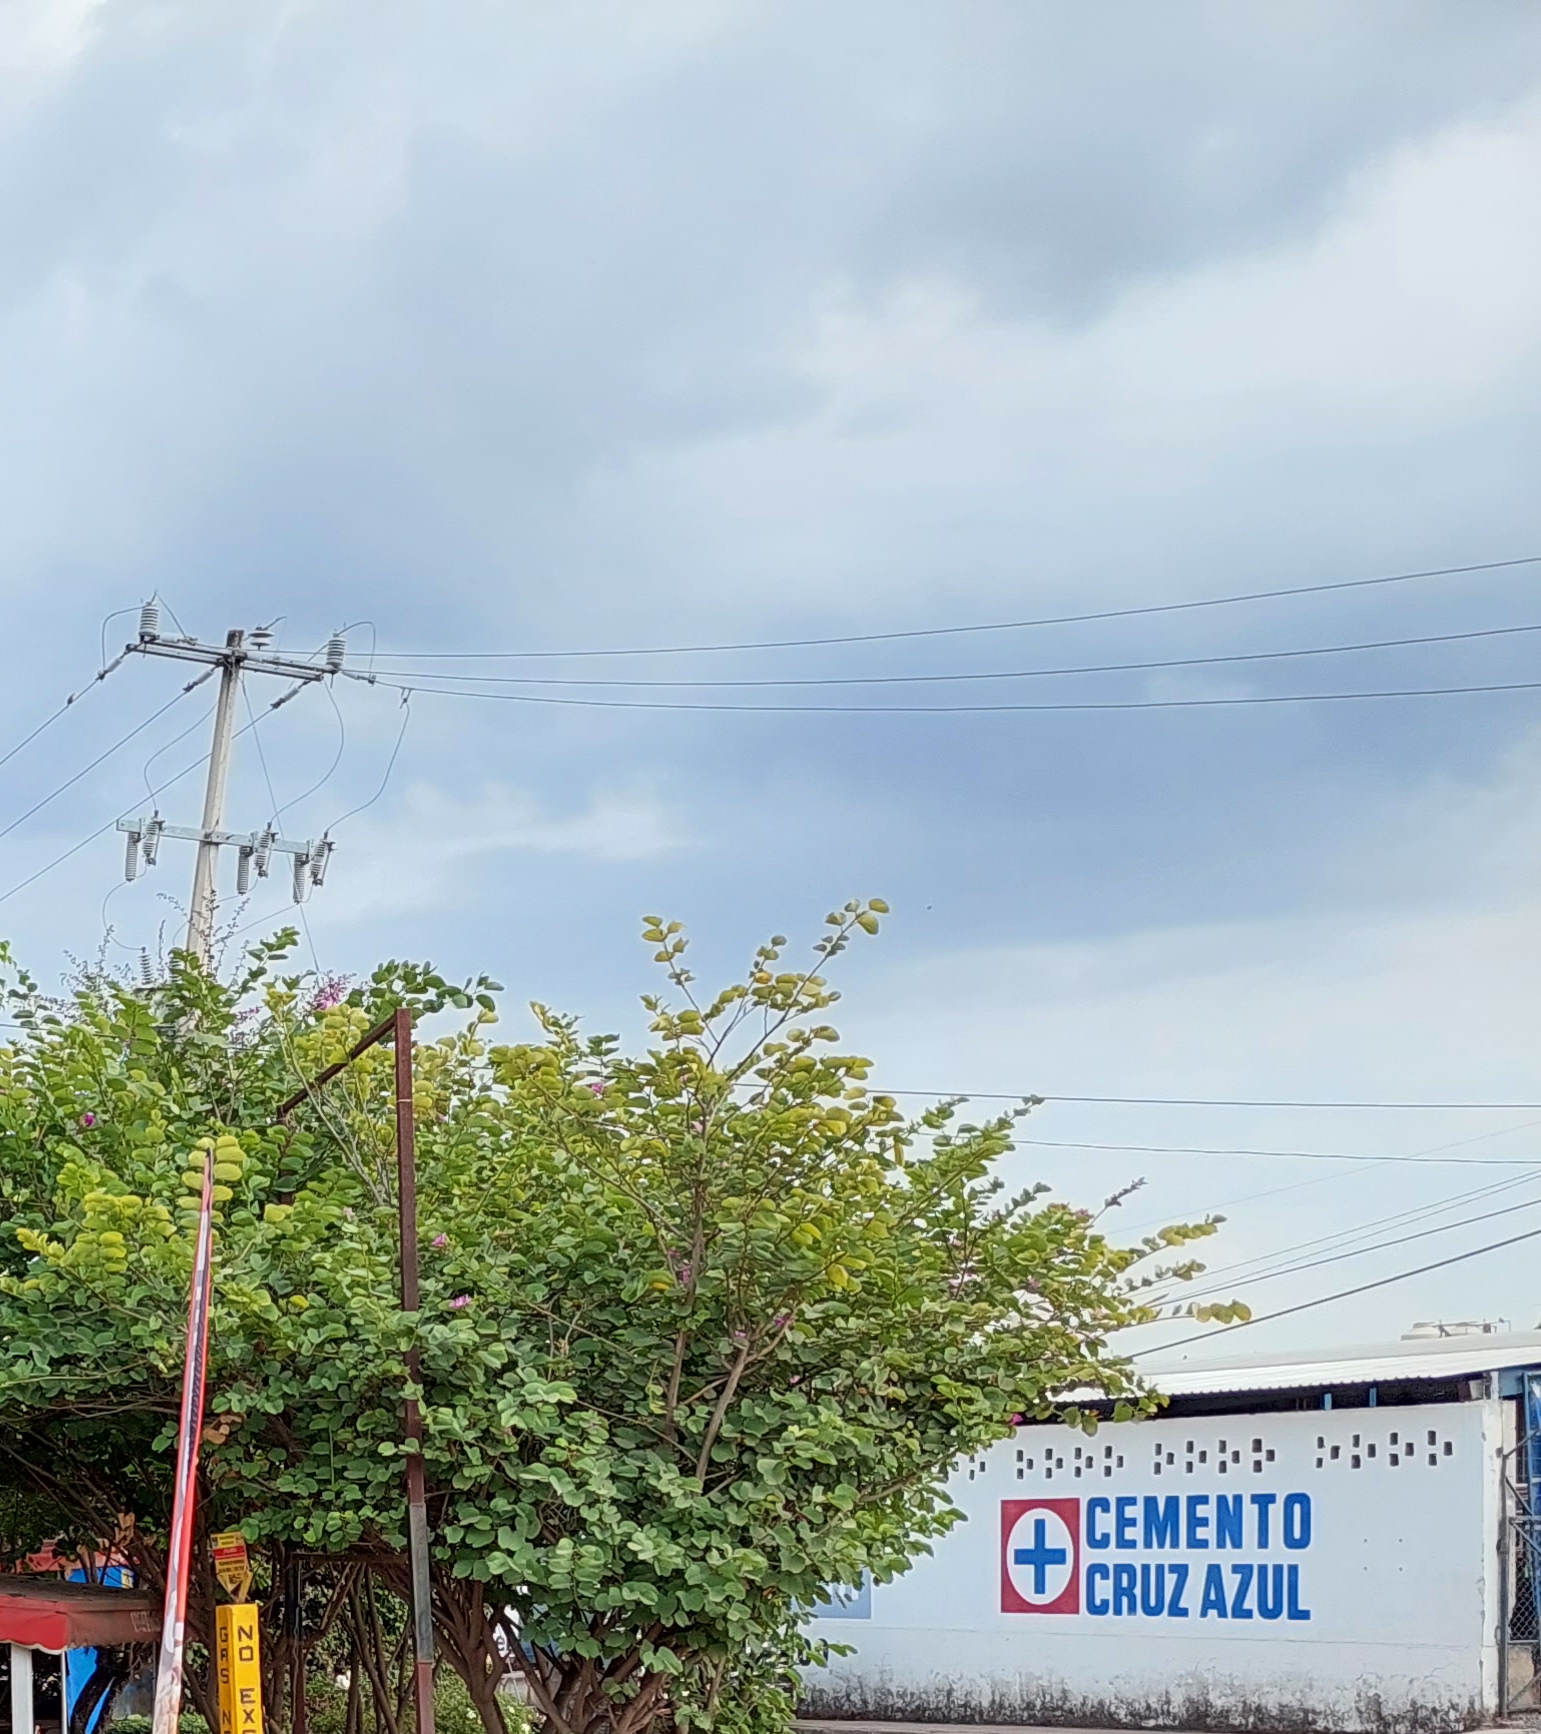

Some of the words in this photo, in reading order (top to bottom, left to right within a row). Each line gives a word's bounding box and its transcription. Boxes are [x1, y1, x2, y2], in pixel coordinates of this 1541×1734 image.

[1086, 1492, 1311, 1549] CEMENTO
[1086, 1563, 1189, 1617] CRUZ
[1199, 1564, 1311, 1620] AZUL
[219, 1626, 230, 1684] GAS
[237, 1625, 254, 1662] NO
